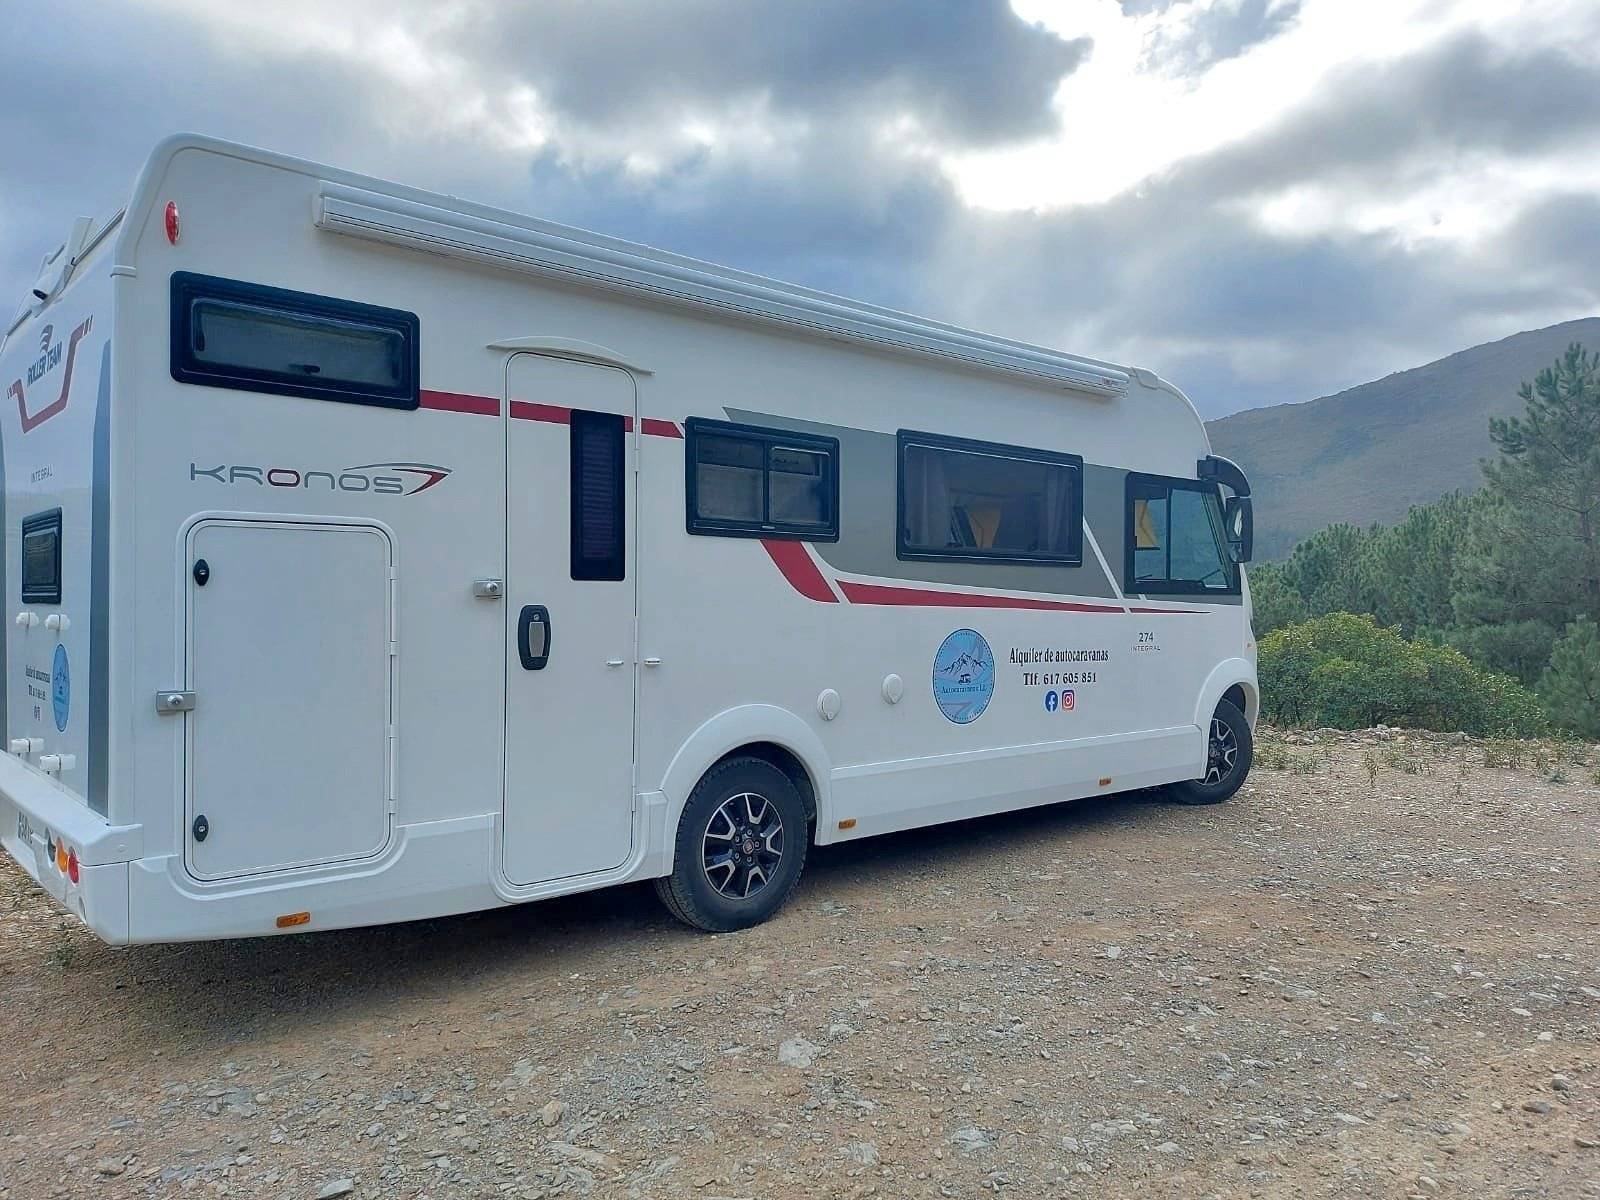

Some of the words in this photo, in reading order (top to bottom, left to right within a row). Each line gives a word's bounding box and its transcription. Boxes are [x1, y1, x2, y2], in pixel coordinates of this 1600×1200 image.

[190, 462, 404, 495] KRONOS
[1138, 631, 1154, 642] 274
[1009, 647, 1042, 667] Alquiler
[1044, 647, 1054, 662] de
[1055, 648, 1109, 662] autocaravanas
[1043, 673, 1060, 685] 617
[1062, 672, 1079, 684] 605
[1081, 671, 1097, 683] 851
